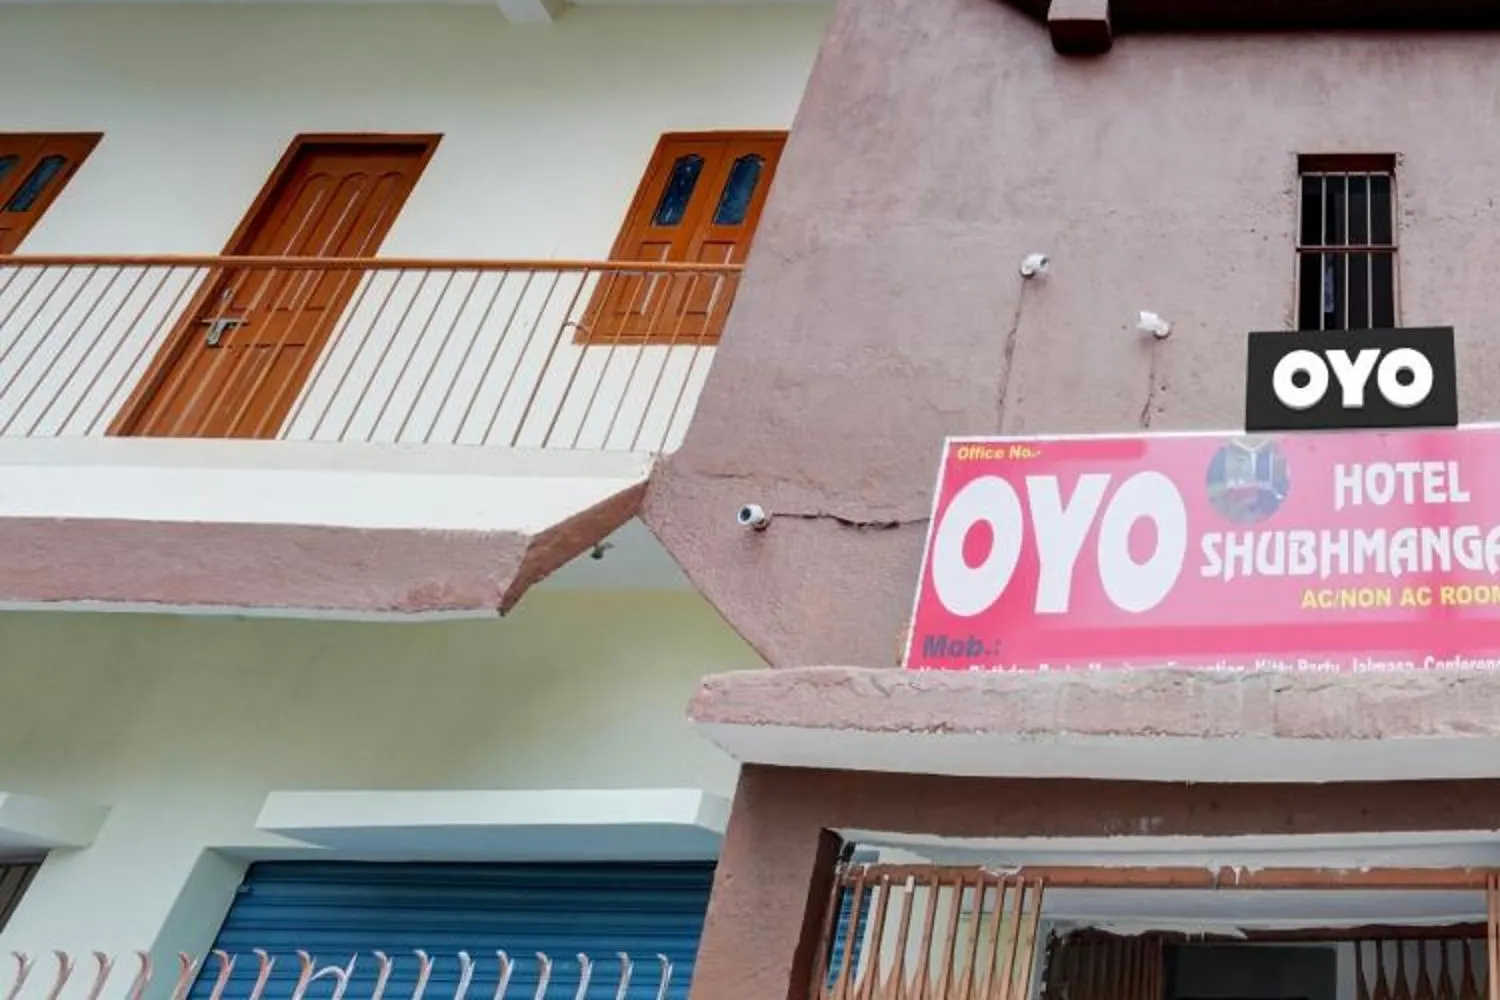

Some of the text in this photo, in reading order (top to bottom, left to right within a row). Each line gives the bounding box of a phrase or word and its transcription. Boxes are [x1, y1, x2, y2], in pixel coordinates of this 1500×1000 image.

[1272, 347, 1434, 410] OYO
[957, 445, 1004, 460] Office
[1333, 461, 1471, 511] HOTEL
[931, 470, 1188, 617] OYO
[1300, 587, 1392, 609] AC/NON
[1400, 586, 1433, 607] AC
